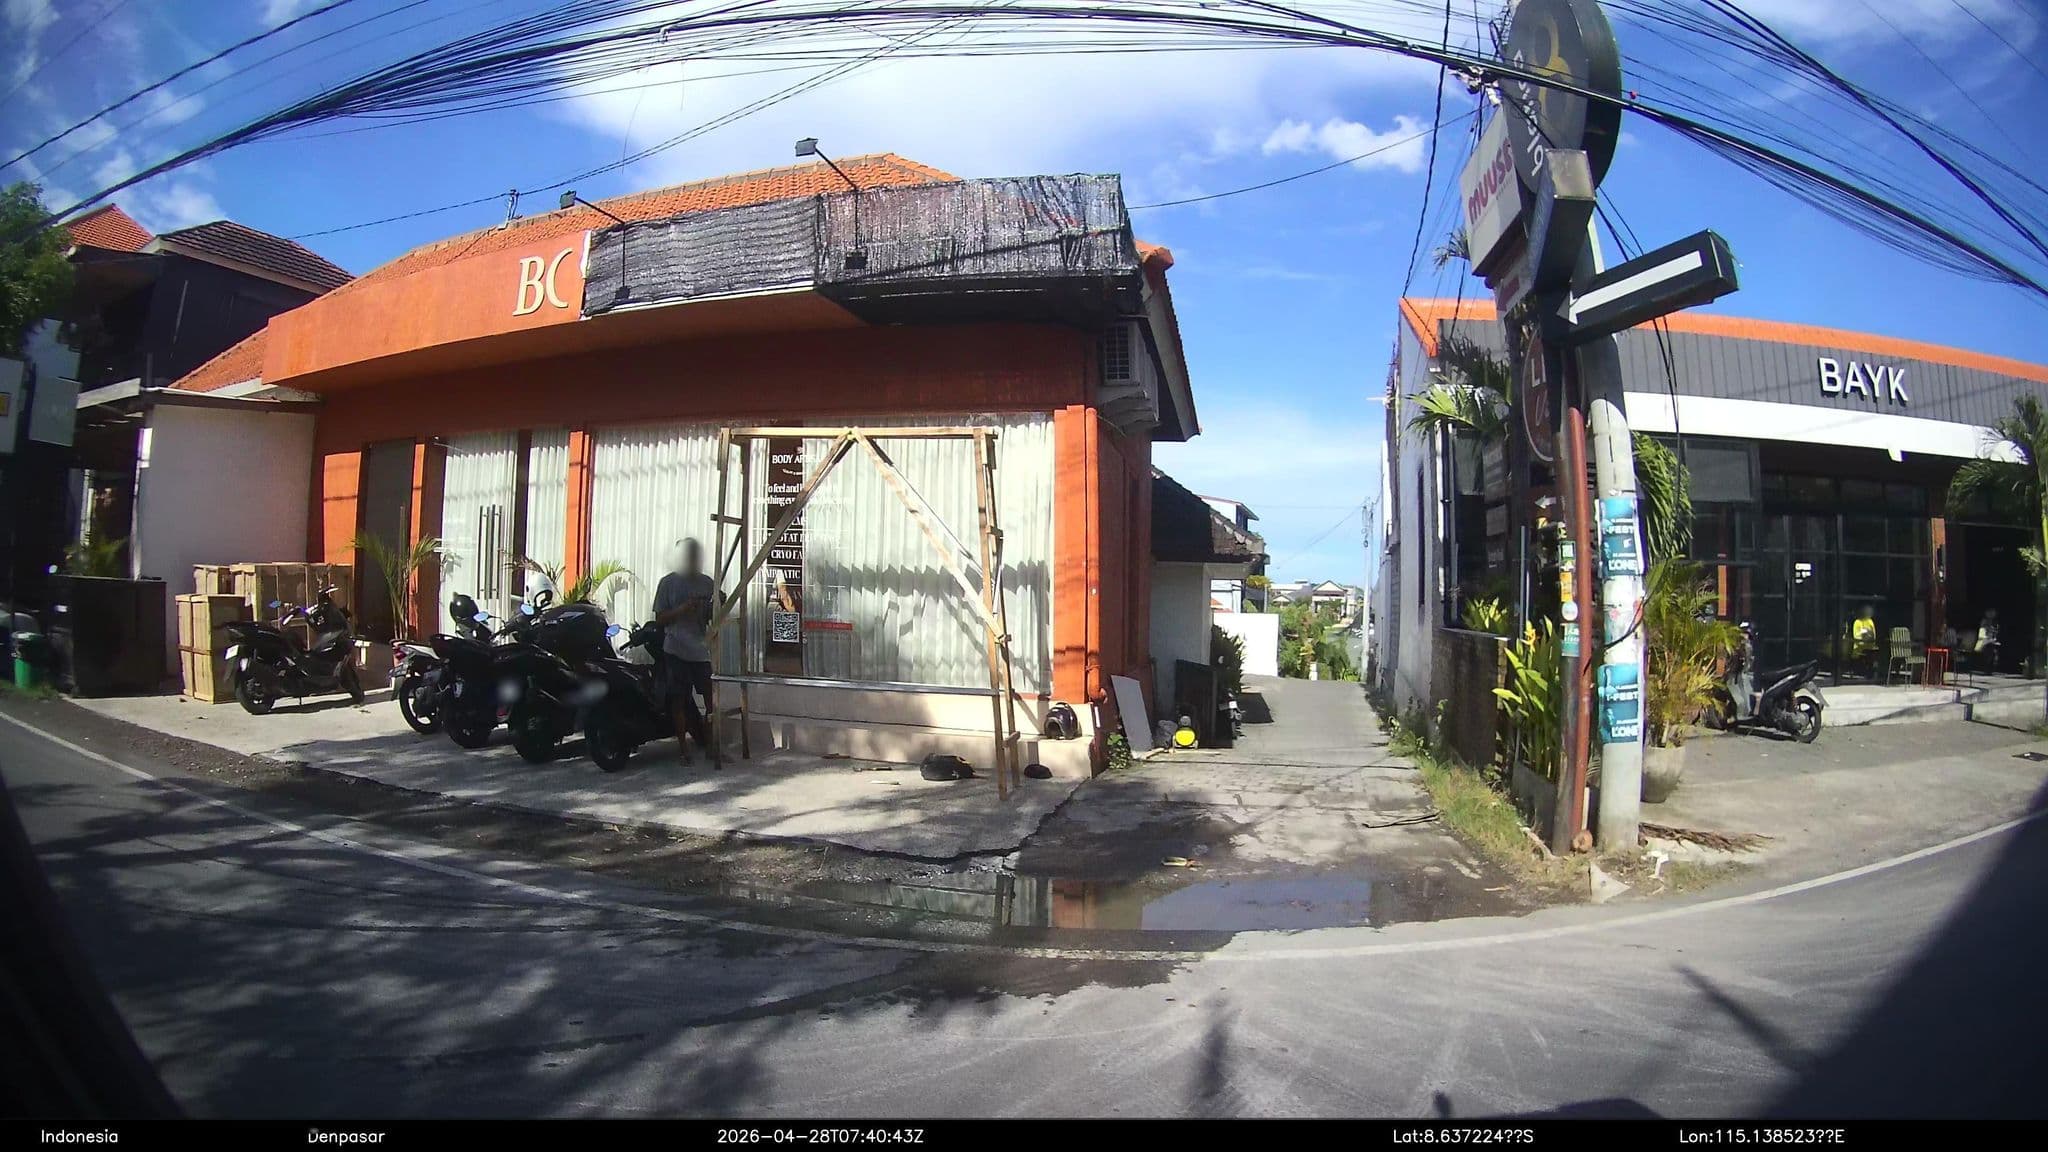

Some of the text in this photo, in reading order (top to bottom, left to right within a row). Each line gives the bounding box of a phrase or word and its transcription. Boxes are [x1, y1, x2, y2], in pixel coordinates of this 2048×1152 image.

[1818, 356, 1909, 402] BAYK
[771, 454, 794, 464] BODY
[786, 483, 800, 493] and
